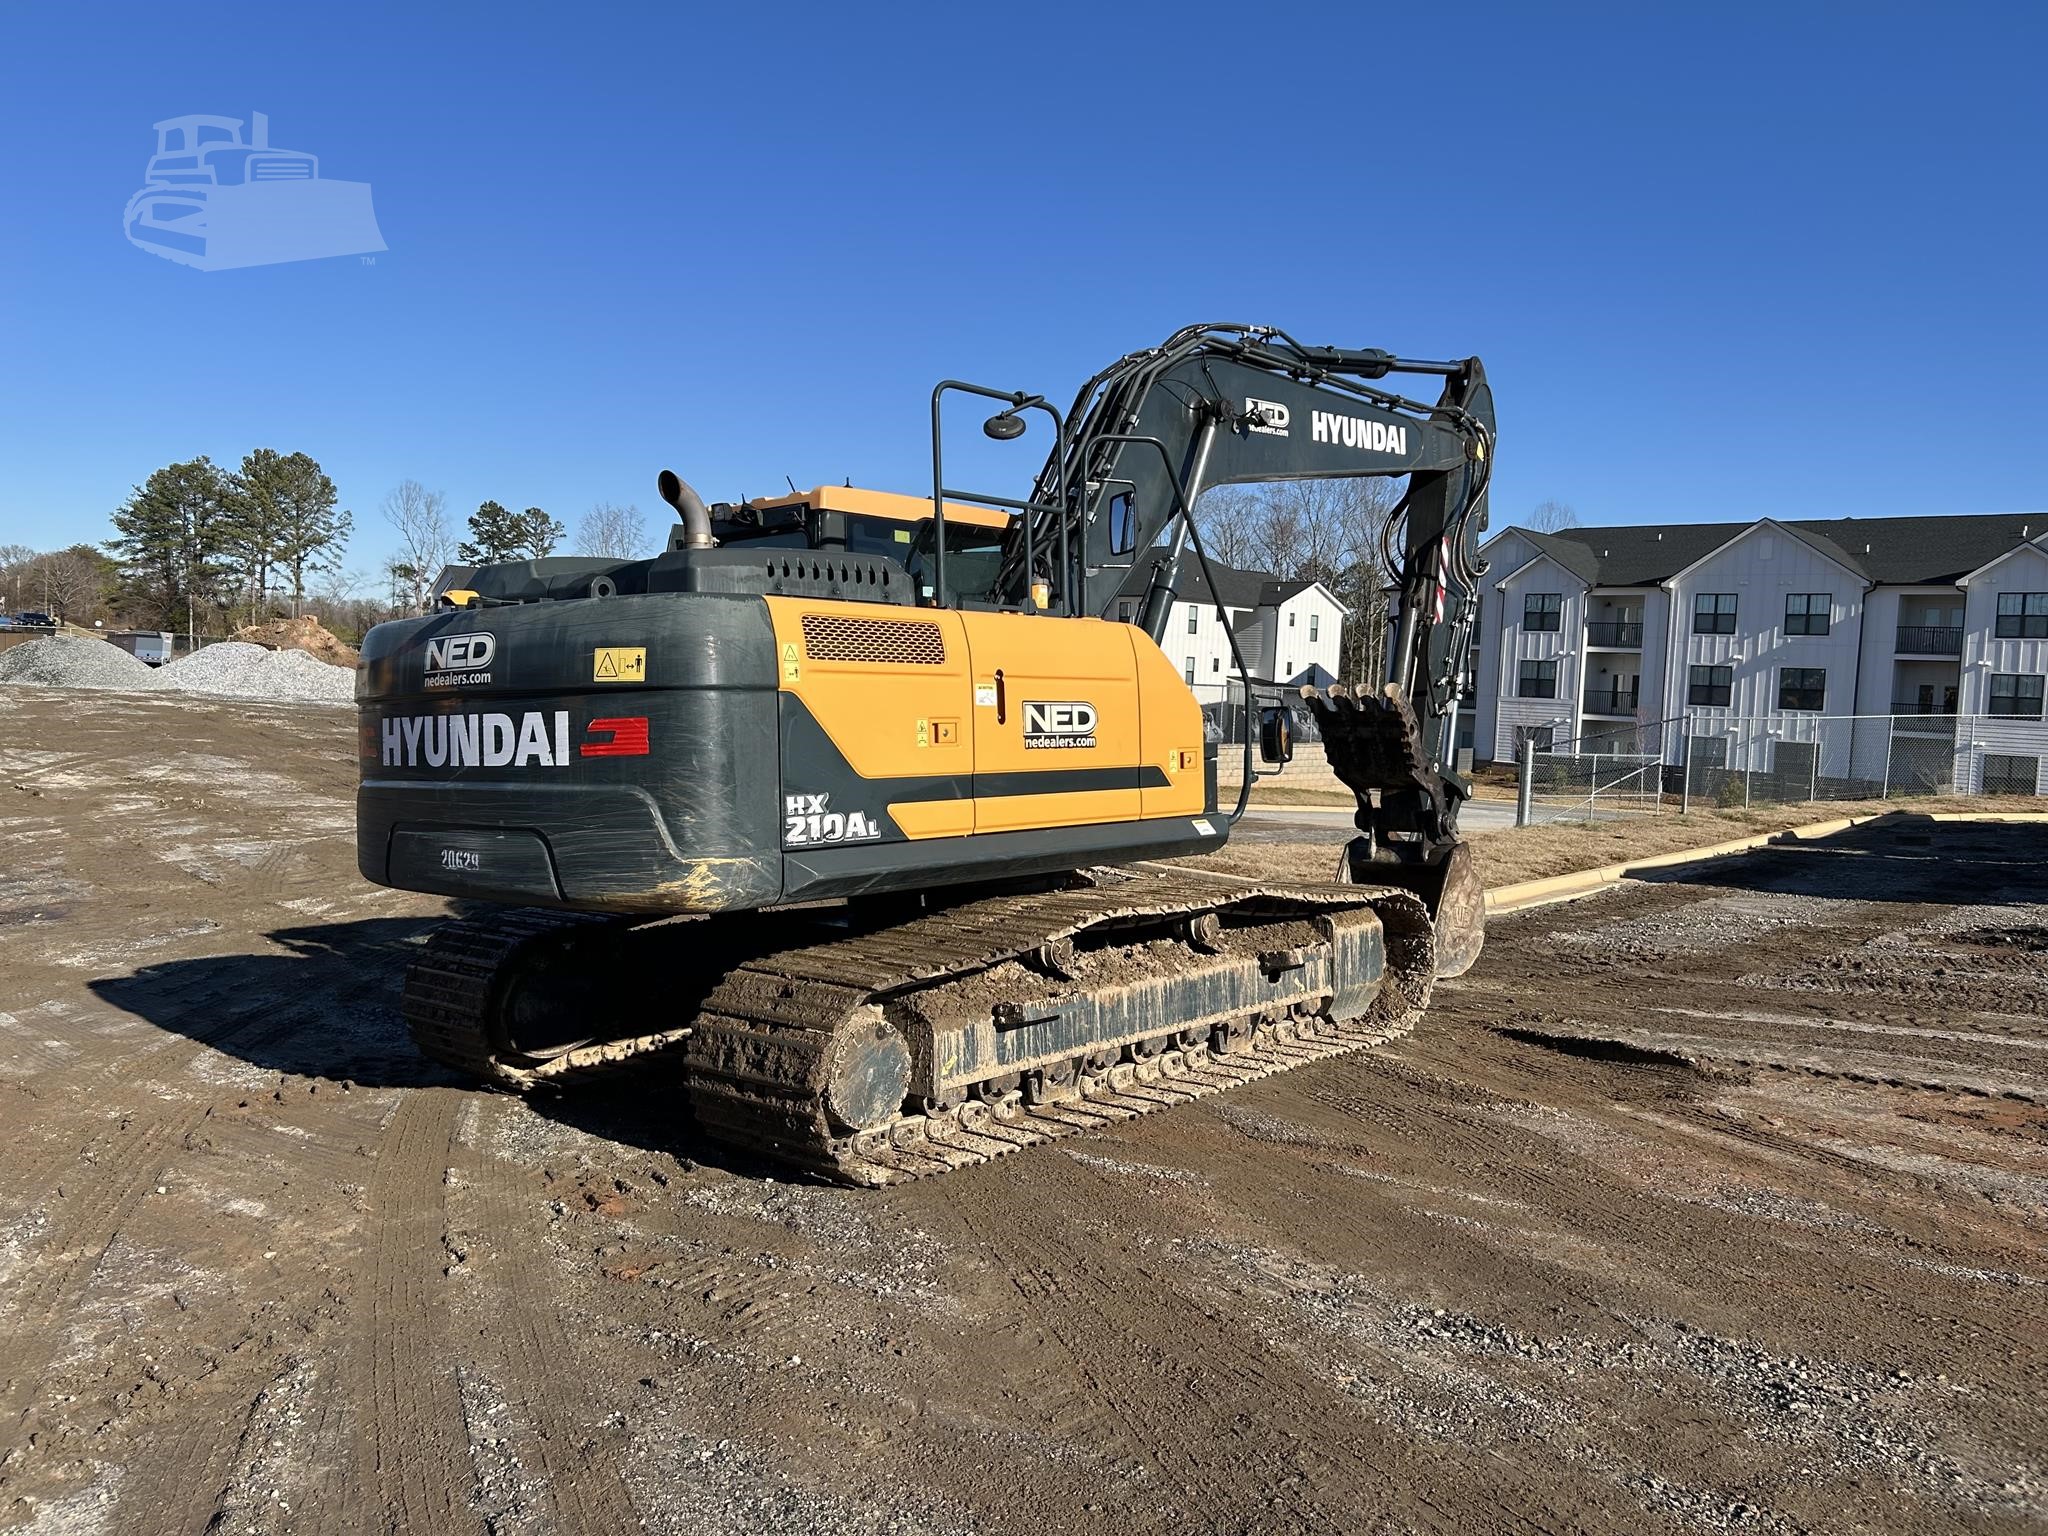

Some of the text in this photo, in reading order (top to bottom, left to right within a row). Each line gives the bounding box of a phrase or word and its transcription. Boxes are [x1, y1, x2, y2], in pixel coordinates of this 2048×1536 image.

[1311, 410, 1406, 455] HYUNDAI
[425, 634, 494, 671] NED
[424, 671, 491, 688] nedealers.com
[1024, 703, 1096, 733] NED
[382, 711, 570, 767] HYUNDAI
[1025, 735, 1096, 748] nedealers.com
[785, 794, 827, 816] HX
